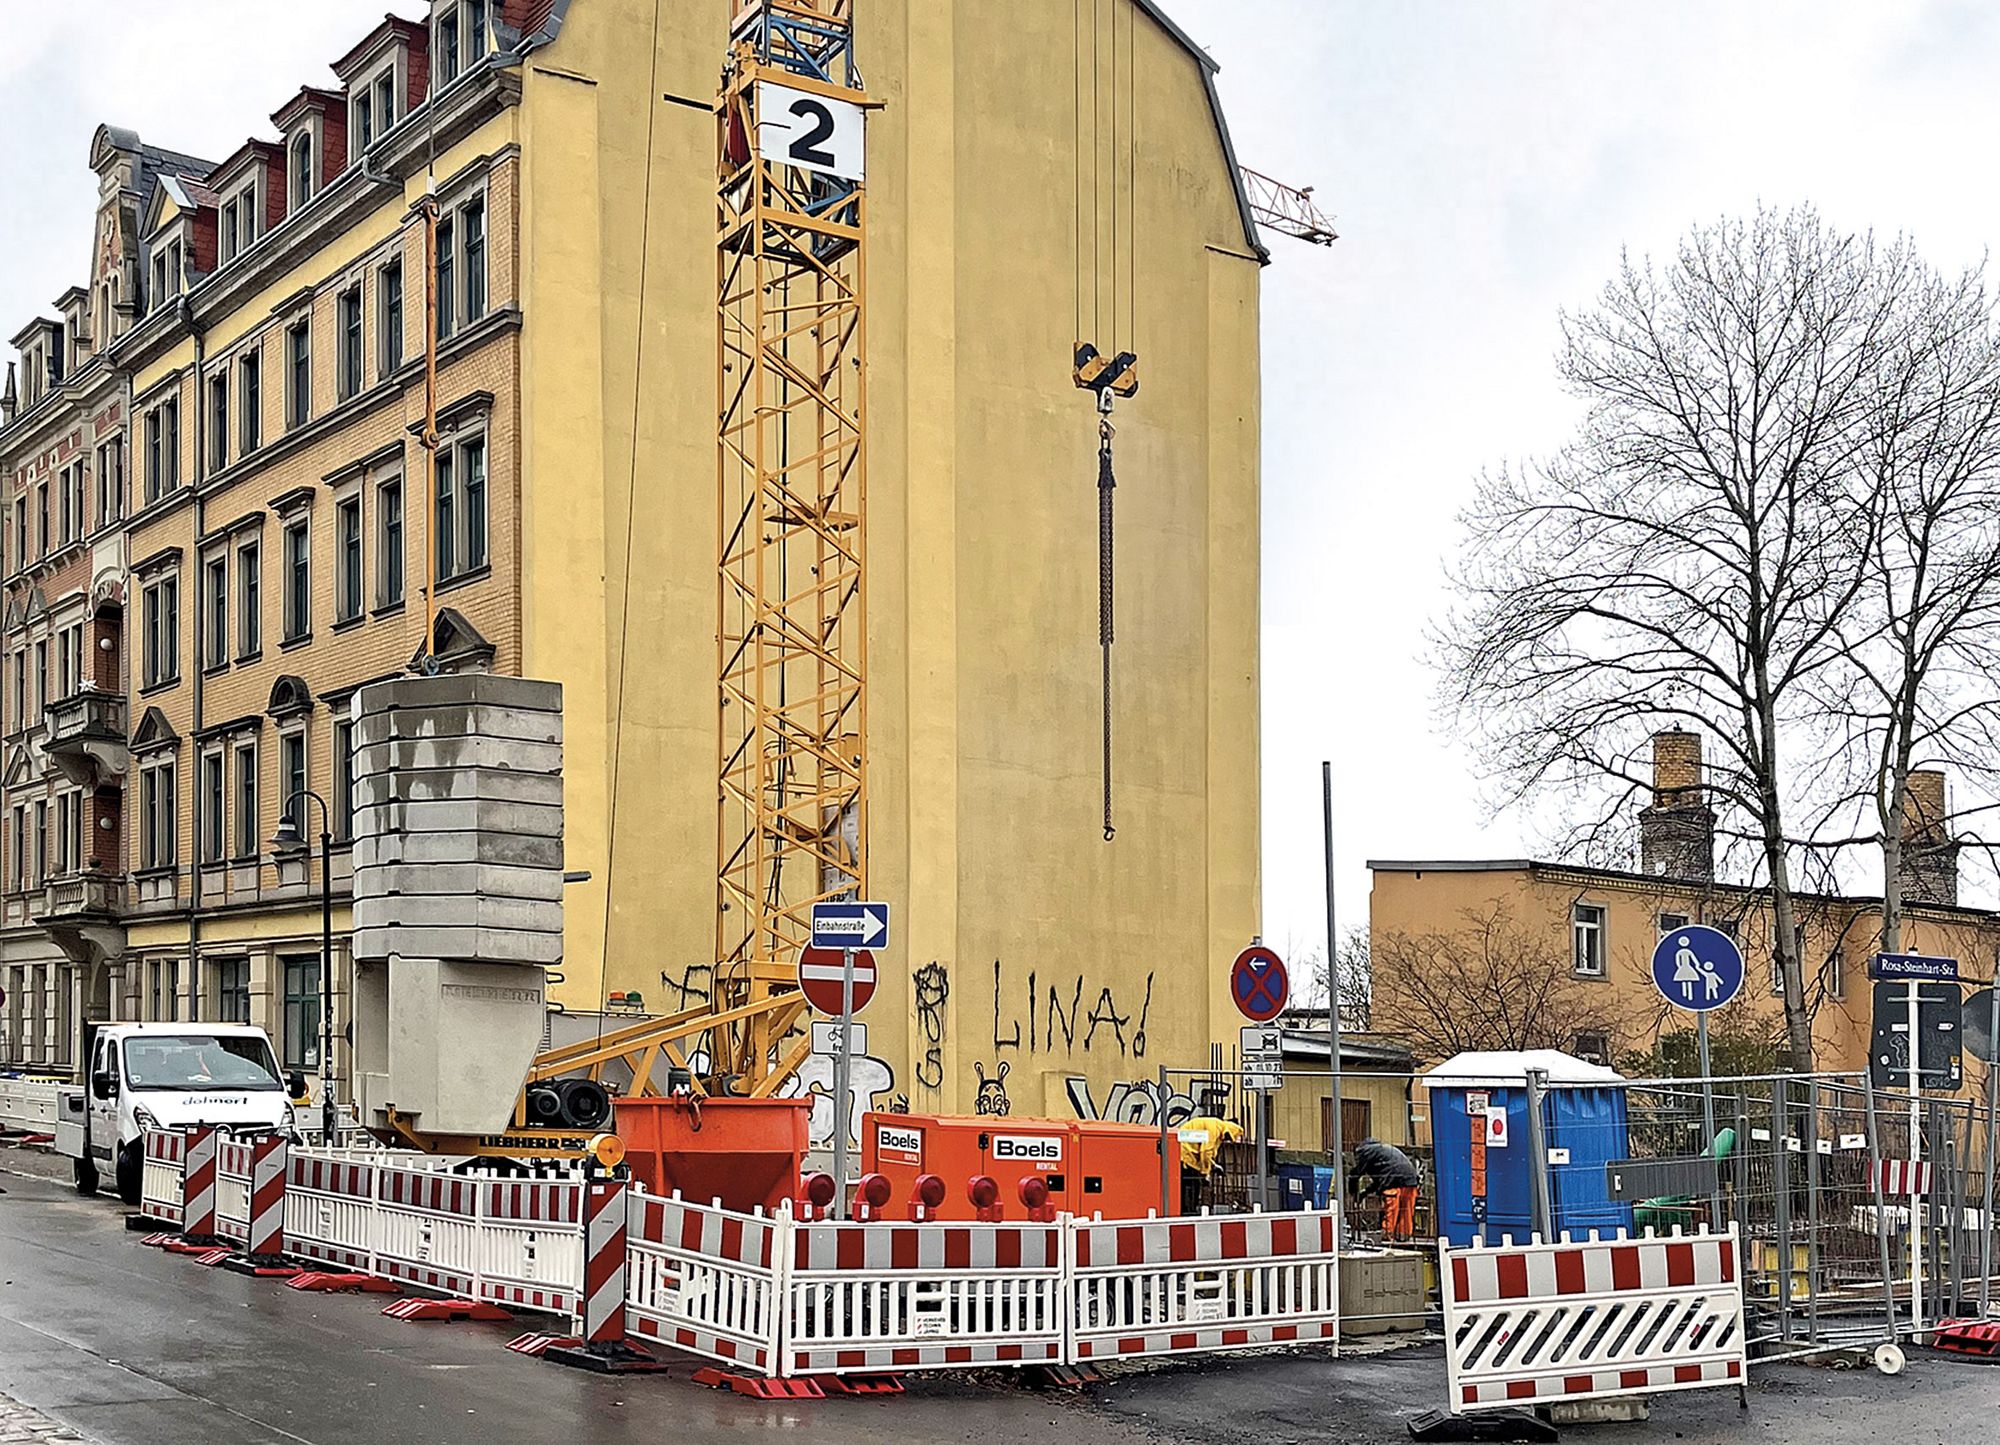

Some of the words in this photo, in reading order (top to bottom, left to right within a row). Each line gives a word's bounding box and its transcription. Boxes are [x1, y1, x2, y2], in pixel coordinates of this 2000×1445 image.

[789, 99, 835, 168] 2
[816, 920, 865, 931] Einbahnstraße
[993, 959, 1154, 1060] LINA!
[479, 1136, 560, 1150] LIEBHERR
[880, 1130, 919, 1150] Boels
[996, 1140, 1059, 1158] Boels
